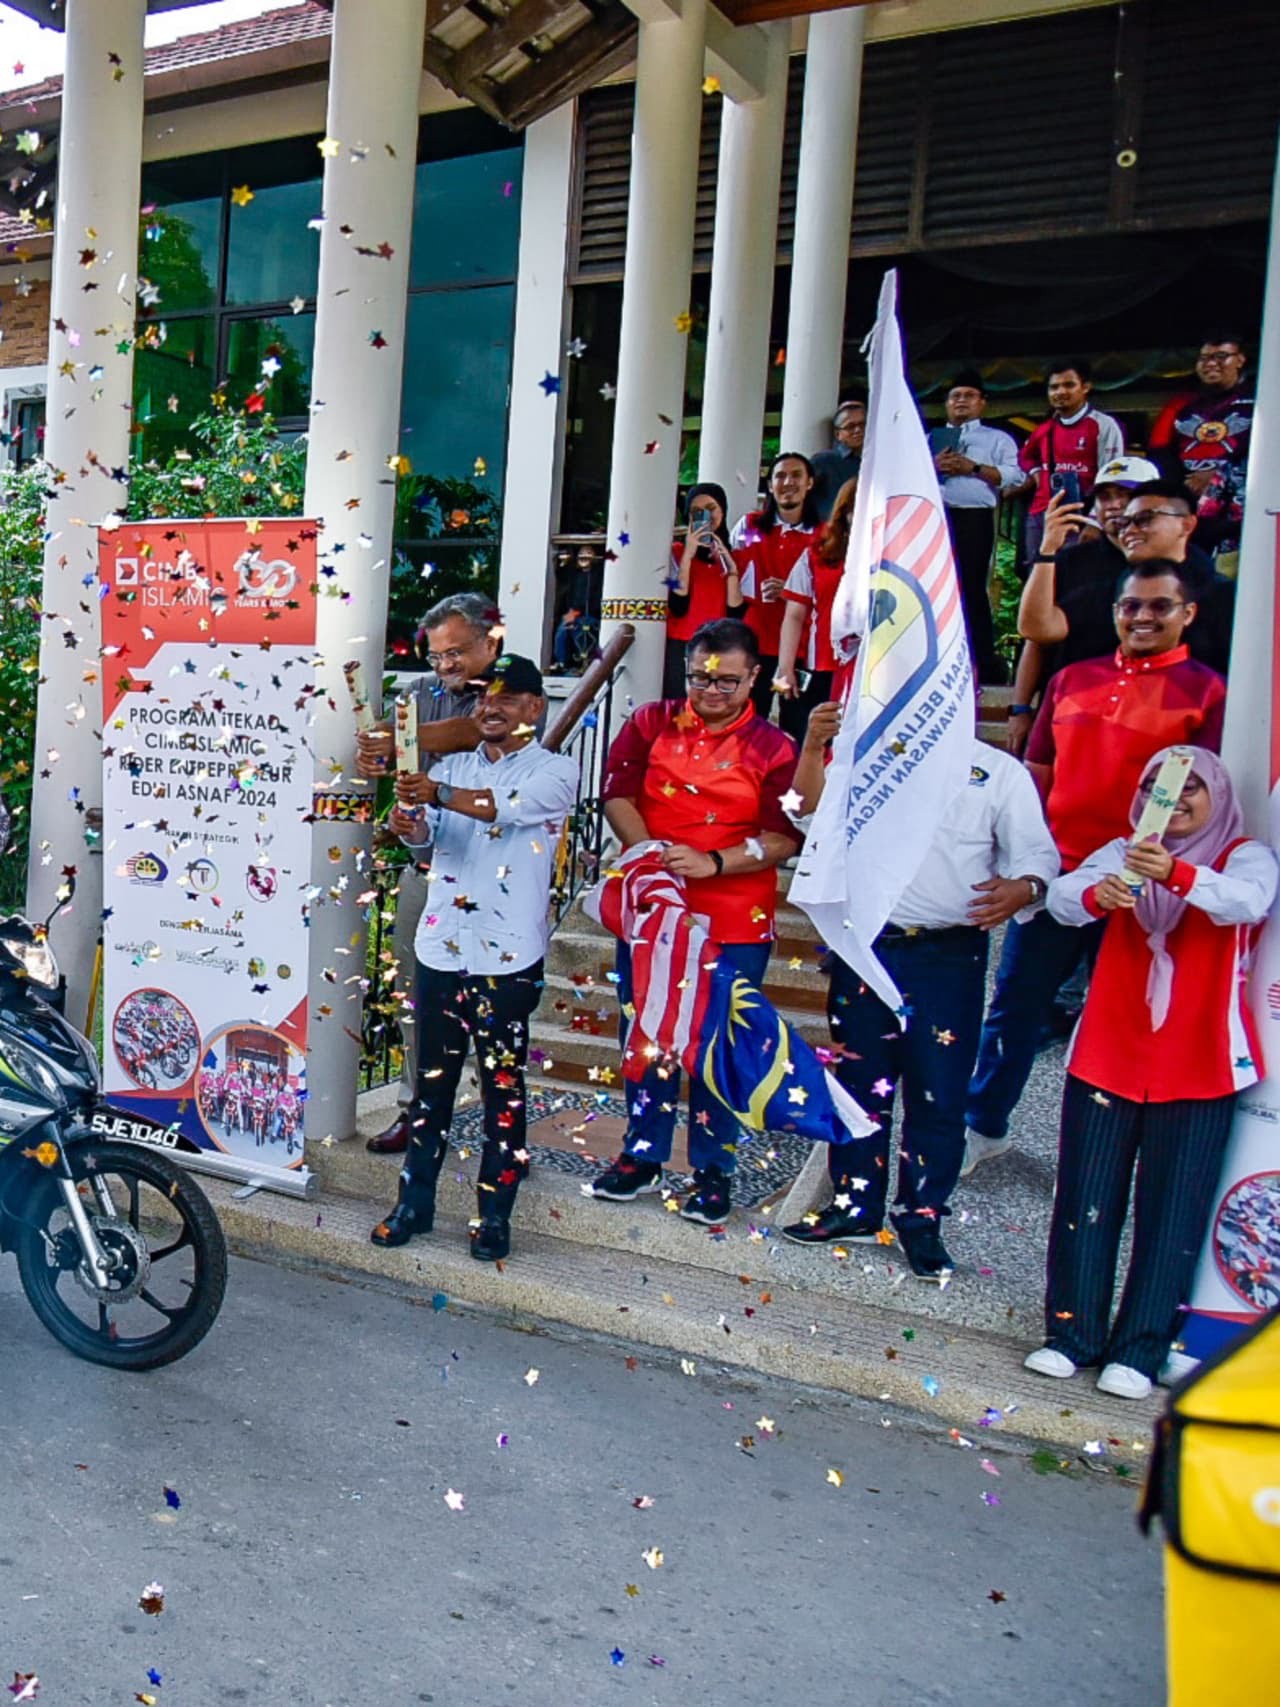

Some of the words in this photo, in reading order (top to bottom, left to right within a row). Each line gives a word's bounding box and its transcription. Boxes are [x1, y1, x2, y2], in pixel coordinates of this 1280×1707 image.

[143, 561, 198, 582] CIMB
[130, 708, 216, 727] PROGRAM
[145, 733, 186, 750] CIMB
[176, 784, 232, 803] ASNAF
[237, 788, 277, 808] 2024
[90, 1114, 179, 1148] SJE1040
